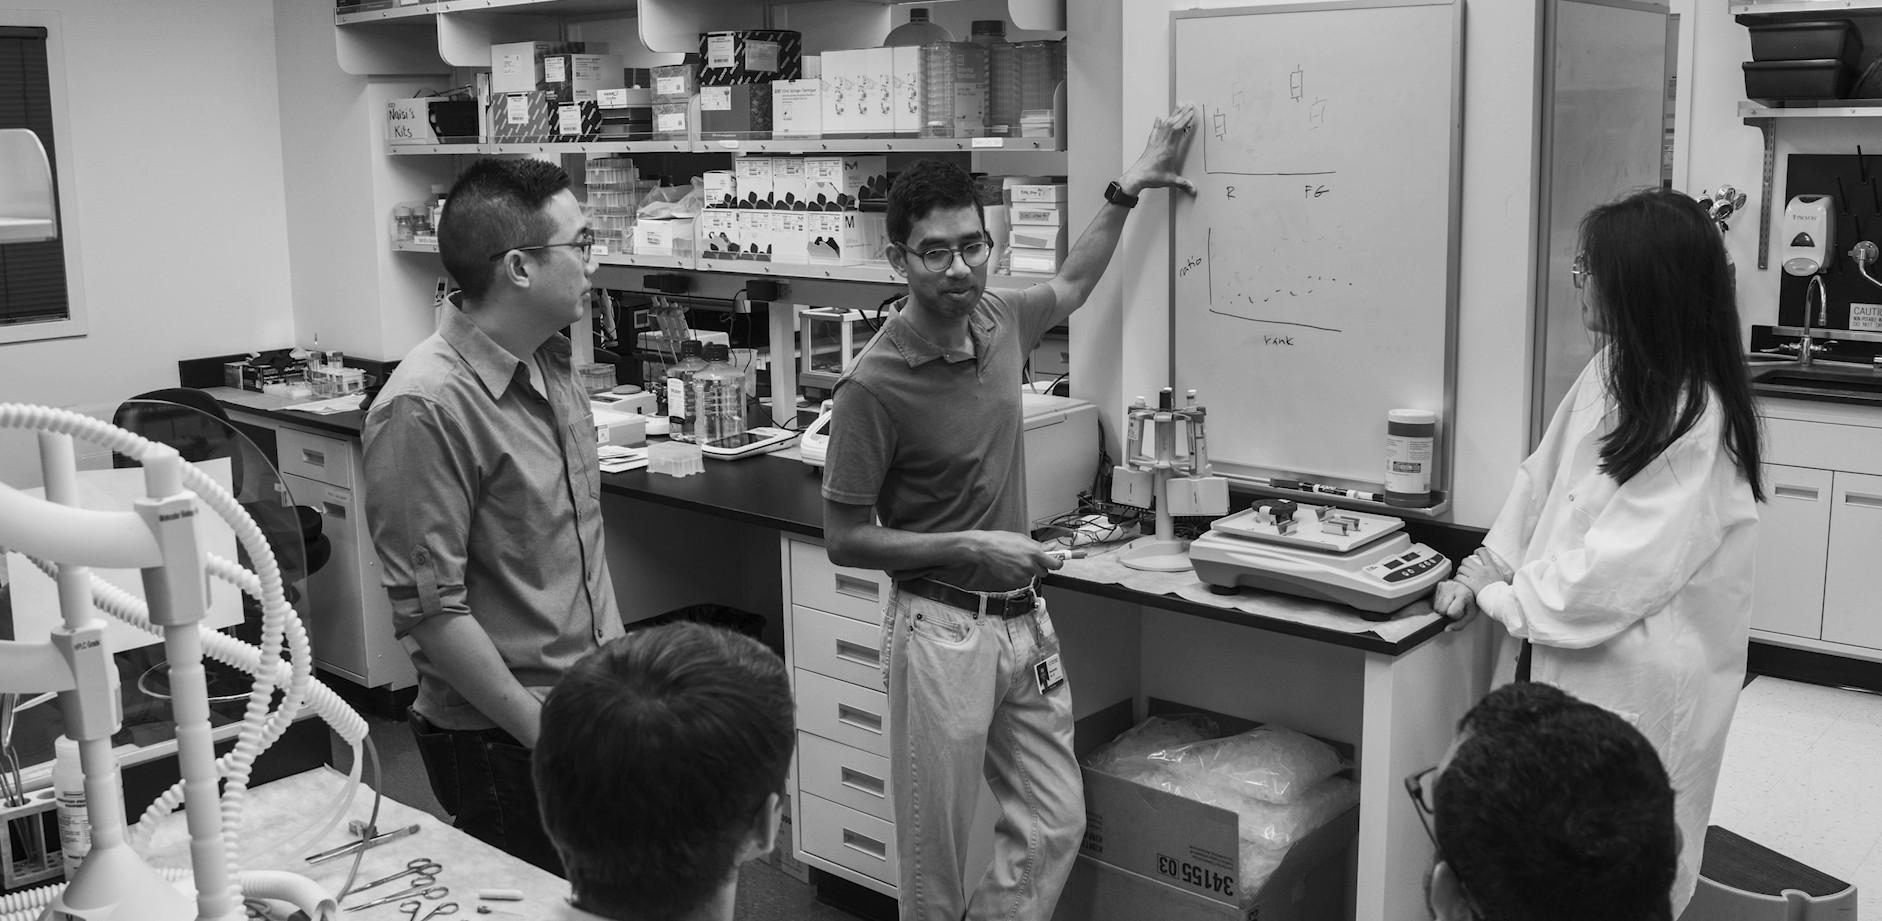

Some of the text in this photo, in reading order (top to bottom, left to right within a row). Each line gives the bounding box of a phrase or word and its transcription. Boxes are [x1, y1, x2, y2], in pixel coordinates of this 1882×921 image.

[394, 125, 413, 138] Kits
[1226, 186, 1236, 200] R
[1180, 255, 1202, 277] ratio
[1264, 335, 1295, 346] rank
[1159, 856, 1178, 876] 03
[1182, 862, 1234, 896] 34155
